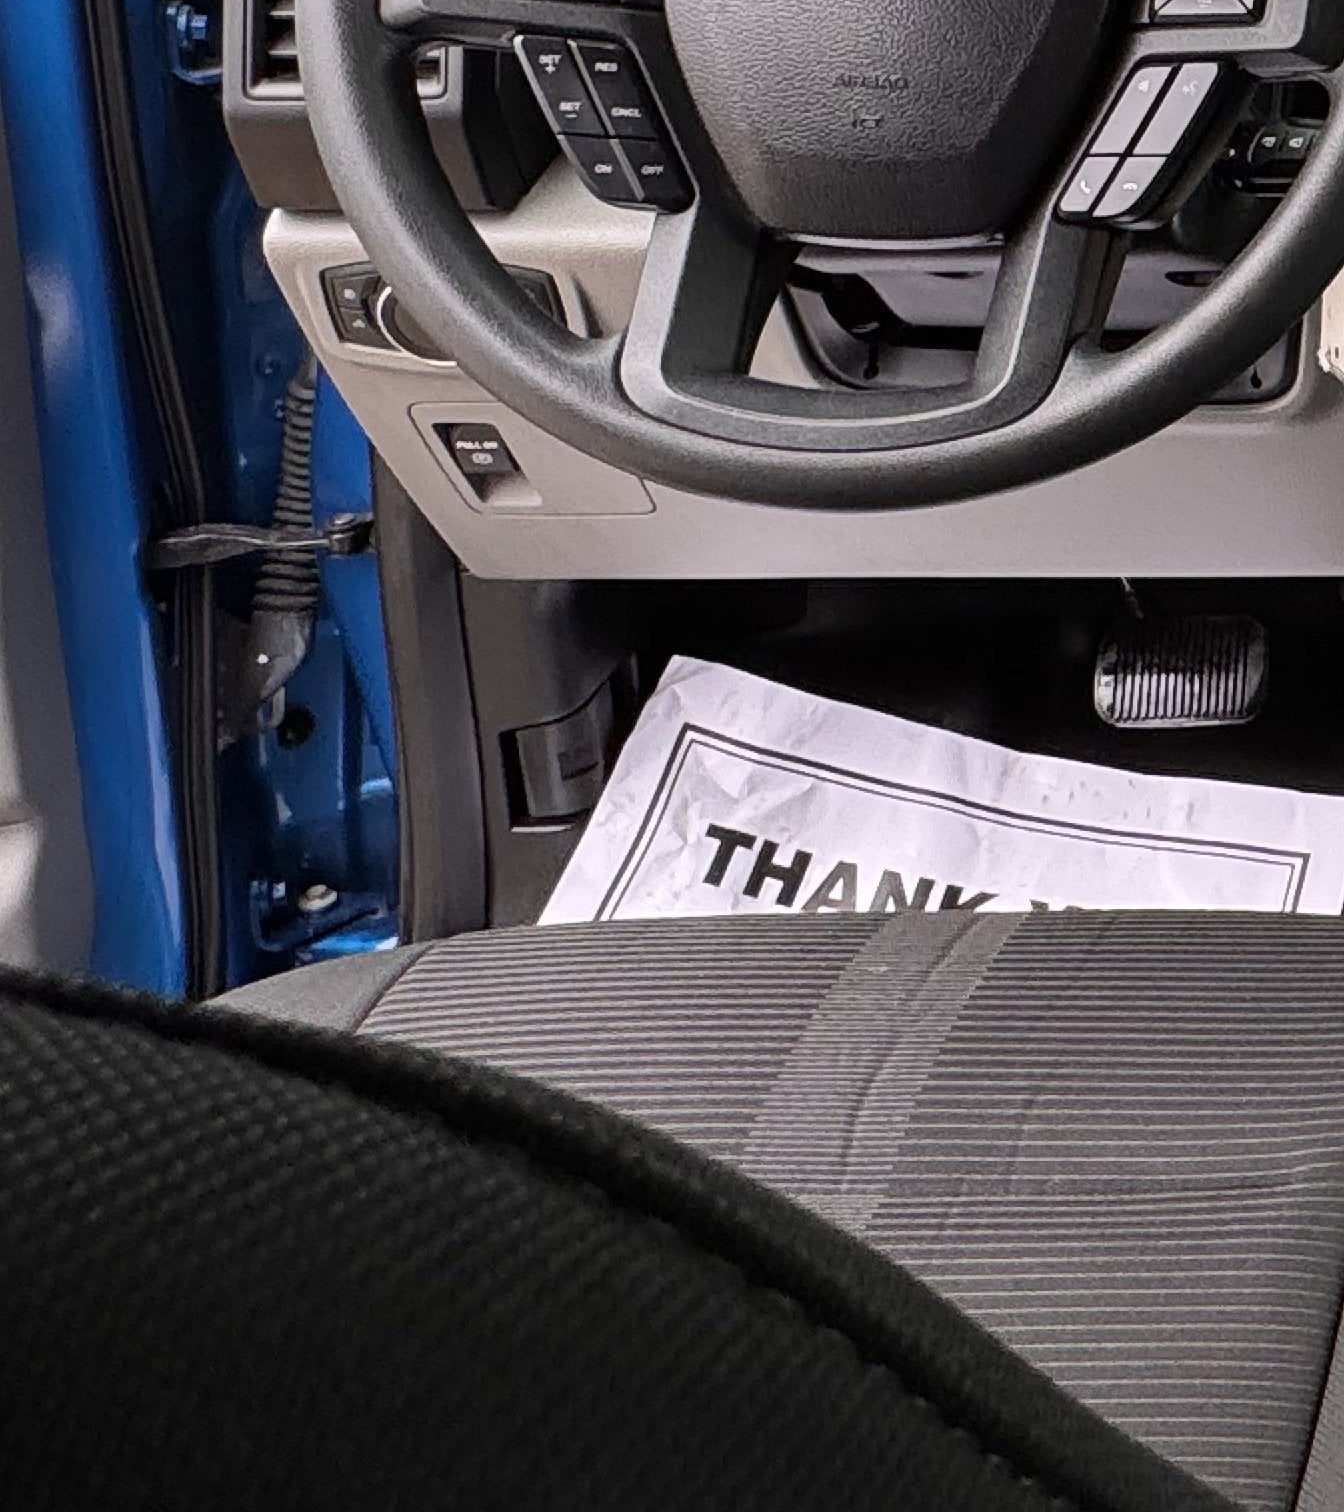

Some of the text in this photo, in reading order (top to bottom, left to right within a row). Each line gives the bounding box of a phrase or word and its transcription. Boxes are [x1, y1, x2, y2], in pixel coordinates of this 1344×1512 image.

[538, 54, 562, 64] SET
[594, 62, 619, 72] RES
[558, 101, 582, 112] SET
[594, 163, 613, 174] ON
[640, 164, 665, 175] OFF
